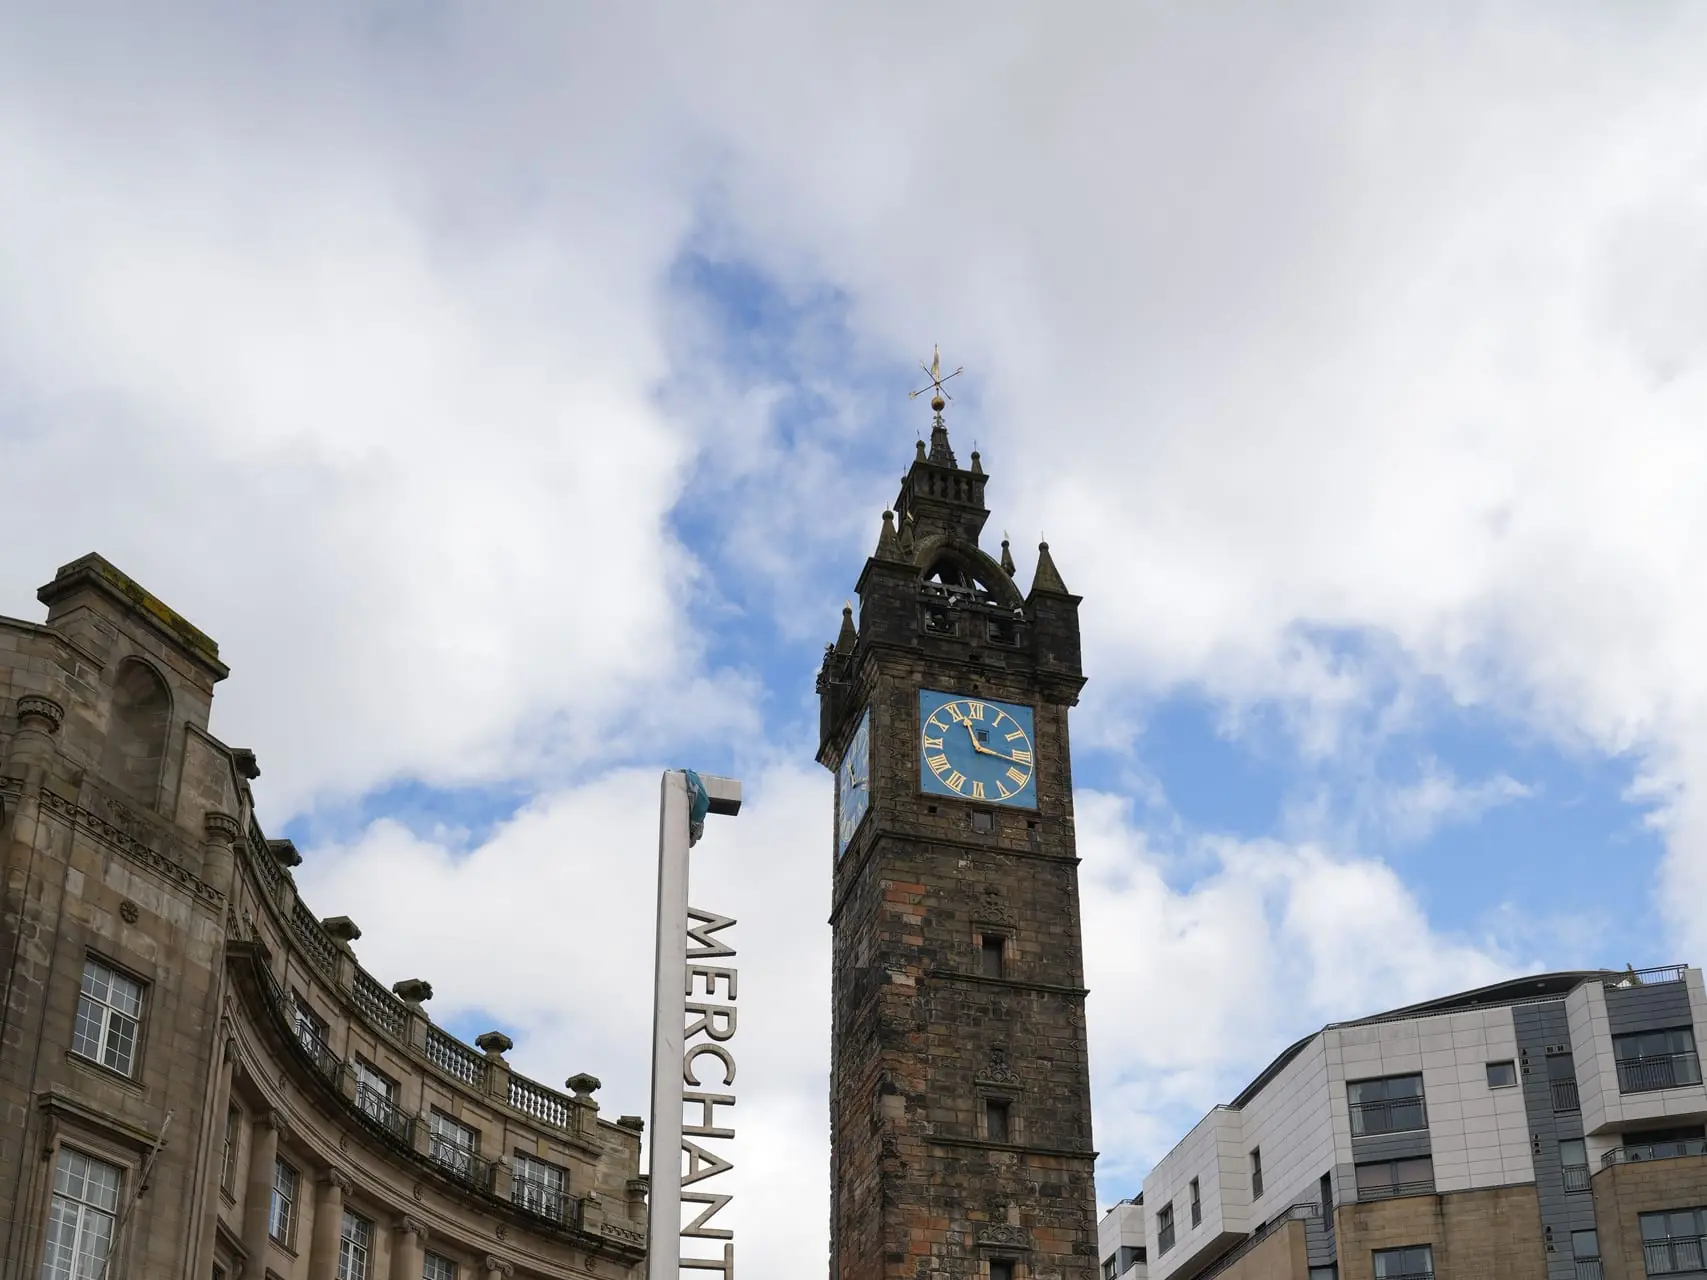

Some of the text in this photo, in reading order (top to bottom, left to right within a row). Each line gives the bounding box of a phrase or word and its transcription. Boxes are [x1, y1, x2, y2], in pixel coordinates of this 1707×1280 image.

[968, 702, 984, 720] XII
[992, 711, 1005, 727] I
[929, 716, 950, 733] X
[972, 781, 986, 799] VI
[996, 780, 1011, 797] V
